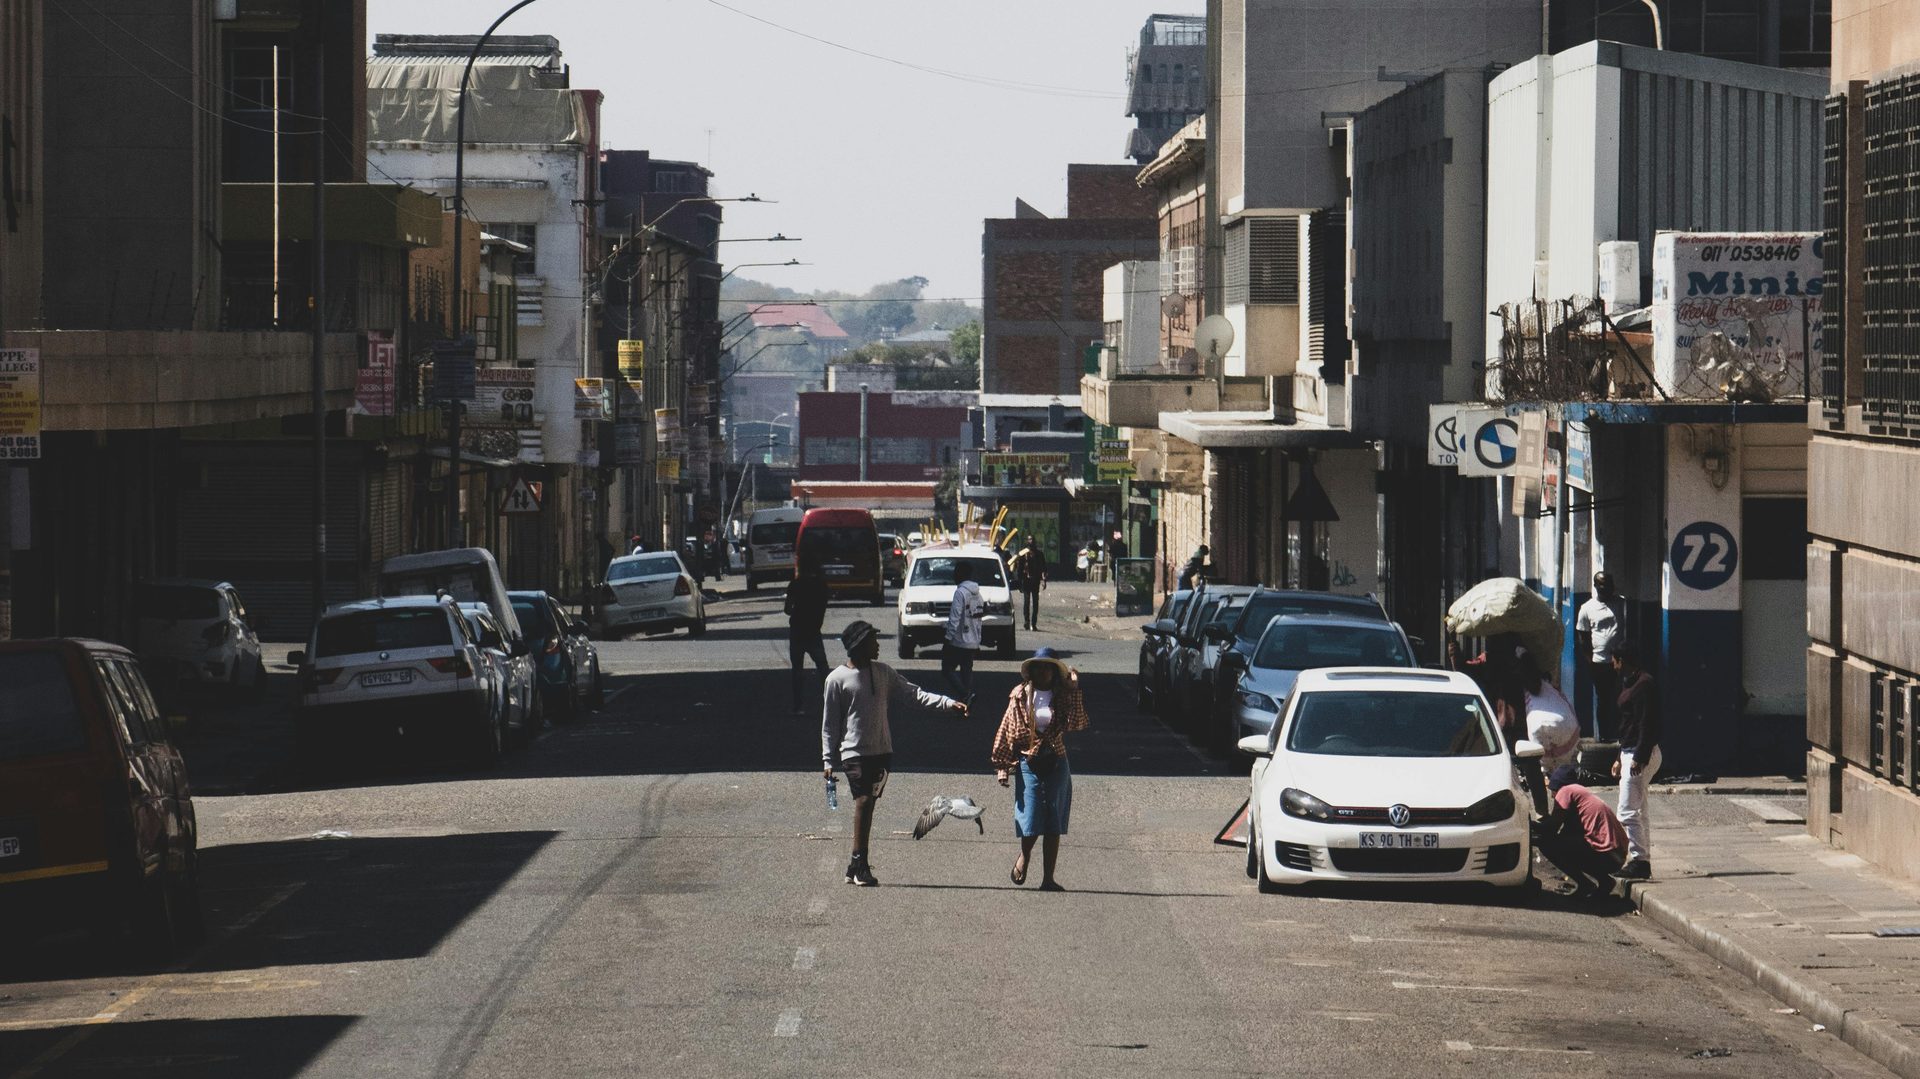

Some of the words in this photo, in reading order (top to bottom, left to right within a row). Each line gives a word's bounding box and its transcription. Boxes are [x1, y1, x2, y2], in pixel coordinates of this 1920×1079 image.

[369, 343, 395, 368] LET
[496, 369, 532, 380] REPAIRS
[1681, 532, 1729, 573] 72
[3, 839, 17, 853] GP
[1361, 834, 1375, 847] KS
[1380, 834, 1393, 847] 90
[1399, 834, 1412, 847] TH
[1423, 834, 1437, 847] GP
